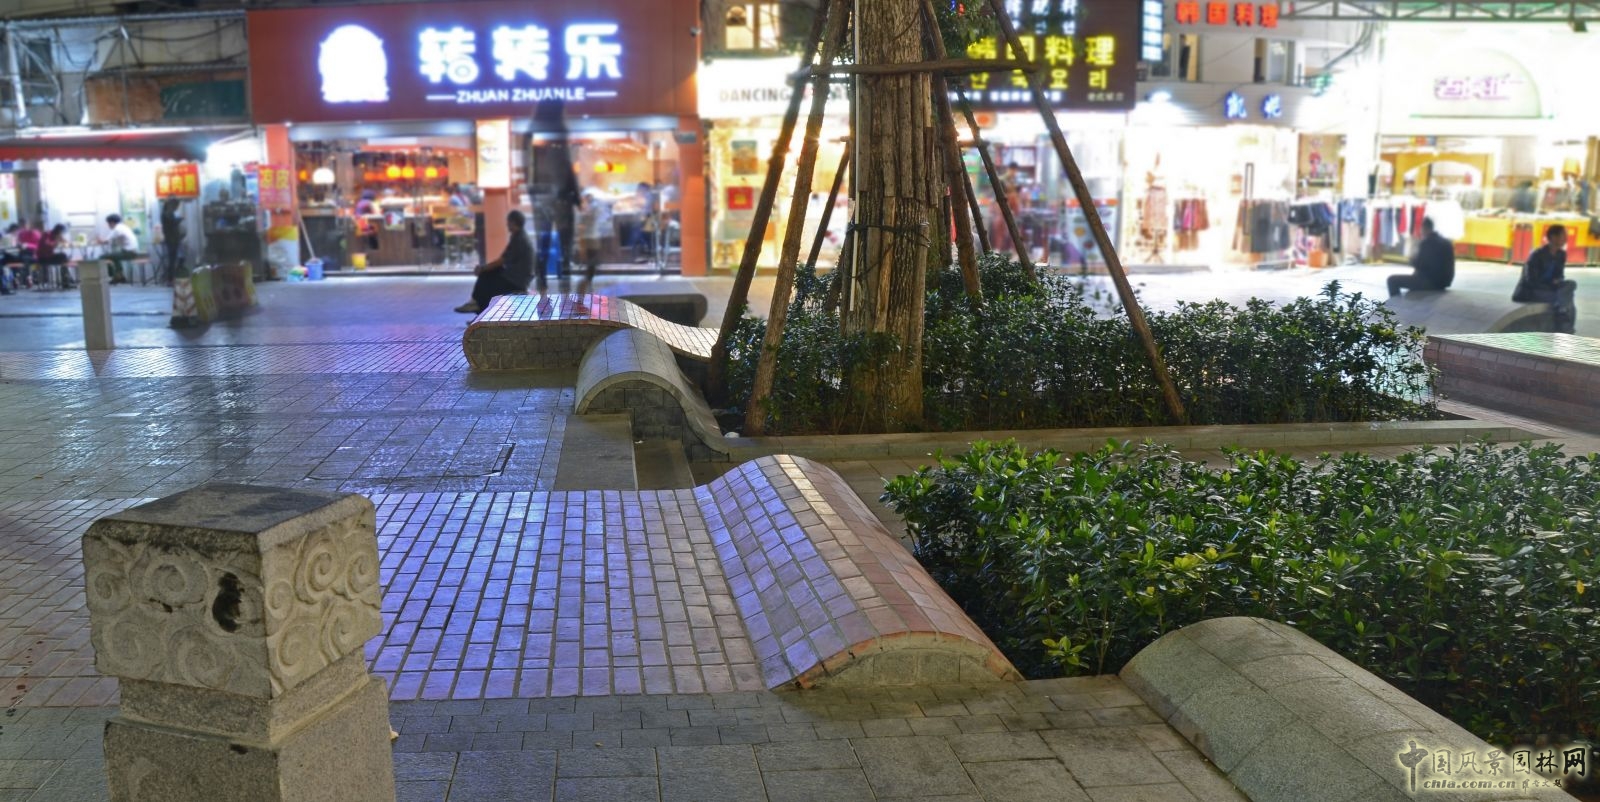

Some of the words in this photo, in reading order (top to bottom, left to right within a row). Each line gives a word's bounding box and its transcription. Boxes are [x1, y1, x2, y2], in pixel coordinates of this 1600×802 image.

[1176, 0, 1279, 28] 韩国料理
[418, 23, 623, 84] 转转乐
[456, 89, 509, 104] ZHUAN
